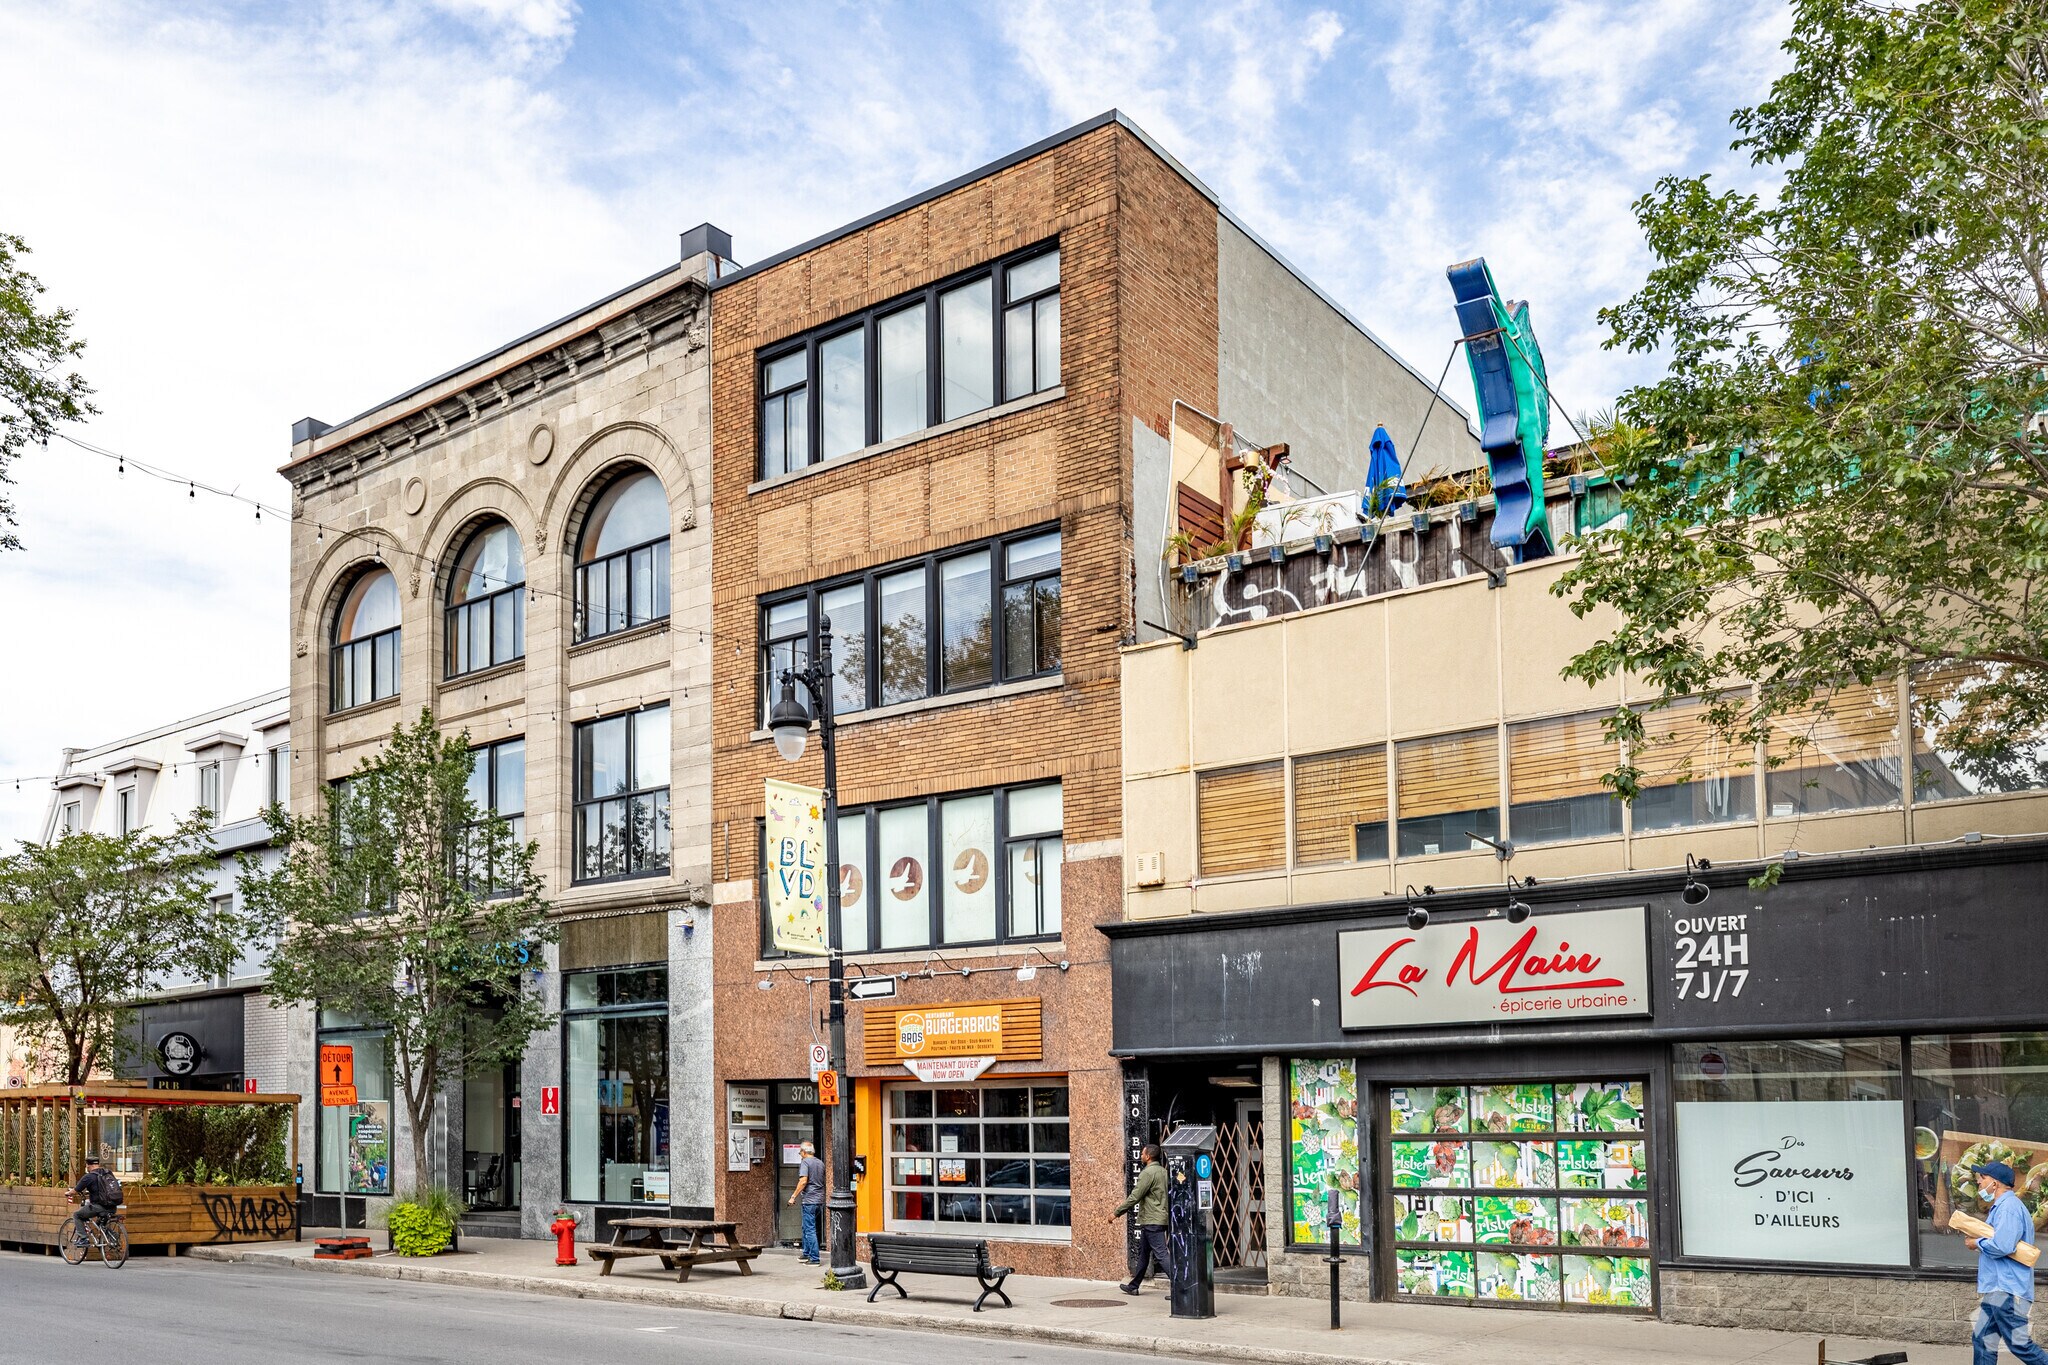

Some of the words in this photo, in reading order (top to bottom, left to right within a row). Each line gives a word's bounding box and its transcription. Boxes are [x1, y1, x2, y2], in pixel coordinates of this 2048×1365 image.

[1675, 914, 1748, 935] OUVERT
[1675, 934, 1749, 970] 24H
[1350, 937, 1429, 998] La
[1446, 925, 1625, 994] Main
[1677, 969, 1750, 1002] 7J/7
[1499, 995, 1563, 1013] épicerie
[1566, 992, 1629, 1008] urbaine
[925, 1015, 1000, 1035] BURGERBROS
[901, 1032, 923, 1043] BROS
[322, 1051, 351, 1063] DÉTOUR
[917, 1061, 956, 1070] MAINTENANT
[957, 1060, 981, 1069] OUVER
[932, 1071, 947, 1079] NOW
[948, 1070, 965, 1079] OPEN
[158, 1080, 180, 1090] PUB
[791, 1085, 814, 1102] 3713
[1514, 1121, 1547, 1130] PILSNER
[1778, 1135, 1805, 1150] Des
[1733, 1150, 1855, 1188] Saveurs
[1775, 1190, 1815, 1204] D'ICI
[1789, 1204, 1799, 1212] et
[1754, 1213, 1841, 1229] D'AILLEURS
